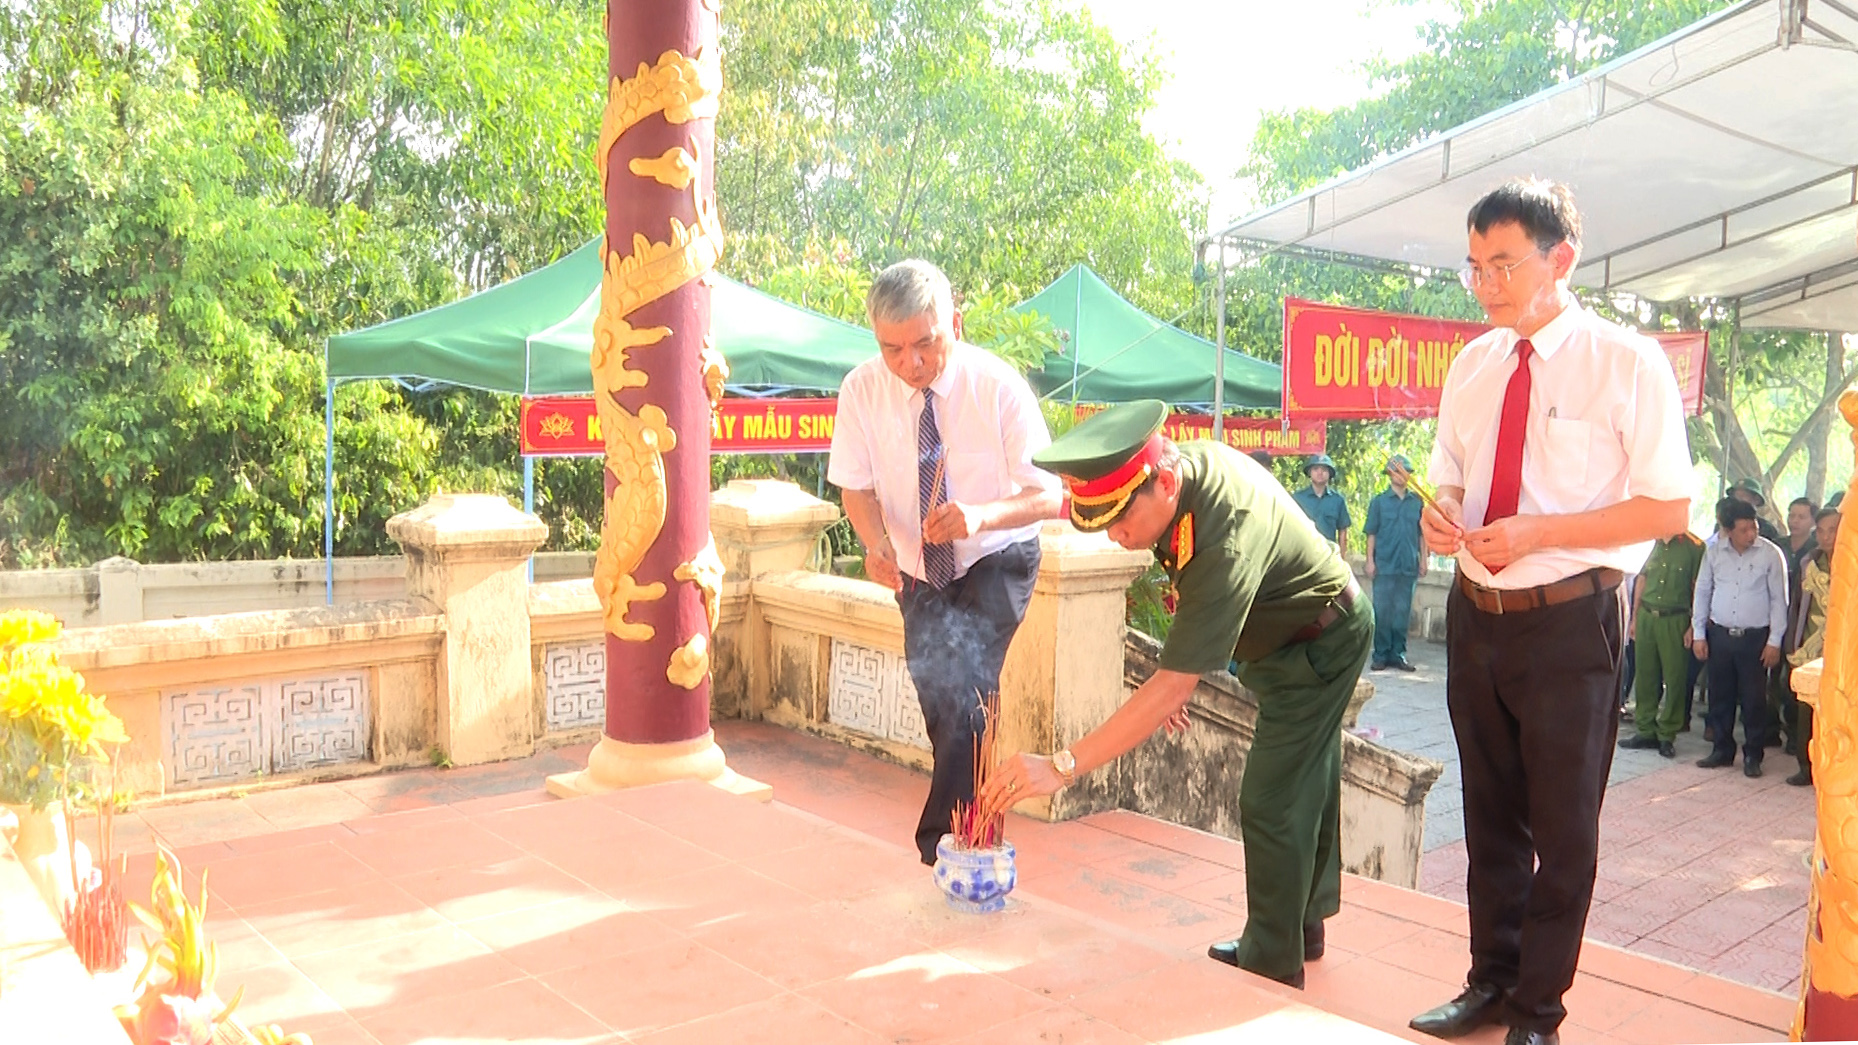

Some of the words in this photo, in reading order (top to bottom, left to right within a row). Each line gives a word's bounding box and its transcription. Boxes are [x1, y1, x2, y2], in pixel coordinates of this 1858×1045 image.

[1314, 323, 1360, 387] ĐỜI
[1366, 326, 1410, 388] ĐỜI
[743, 403, 792, 439] MẪU
[798, 414, 834, 439] SIN
[1231, 428, 1262, 447] SINH
